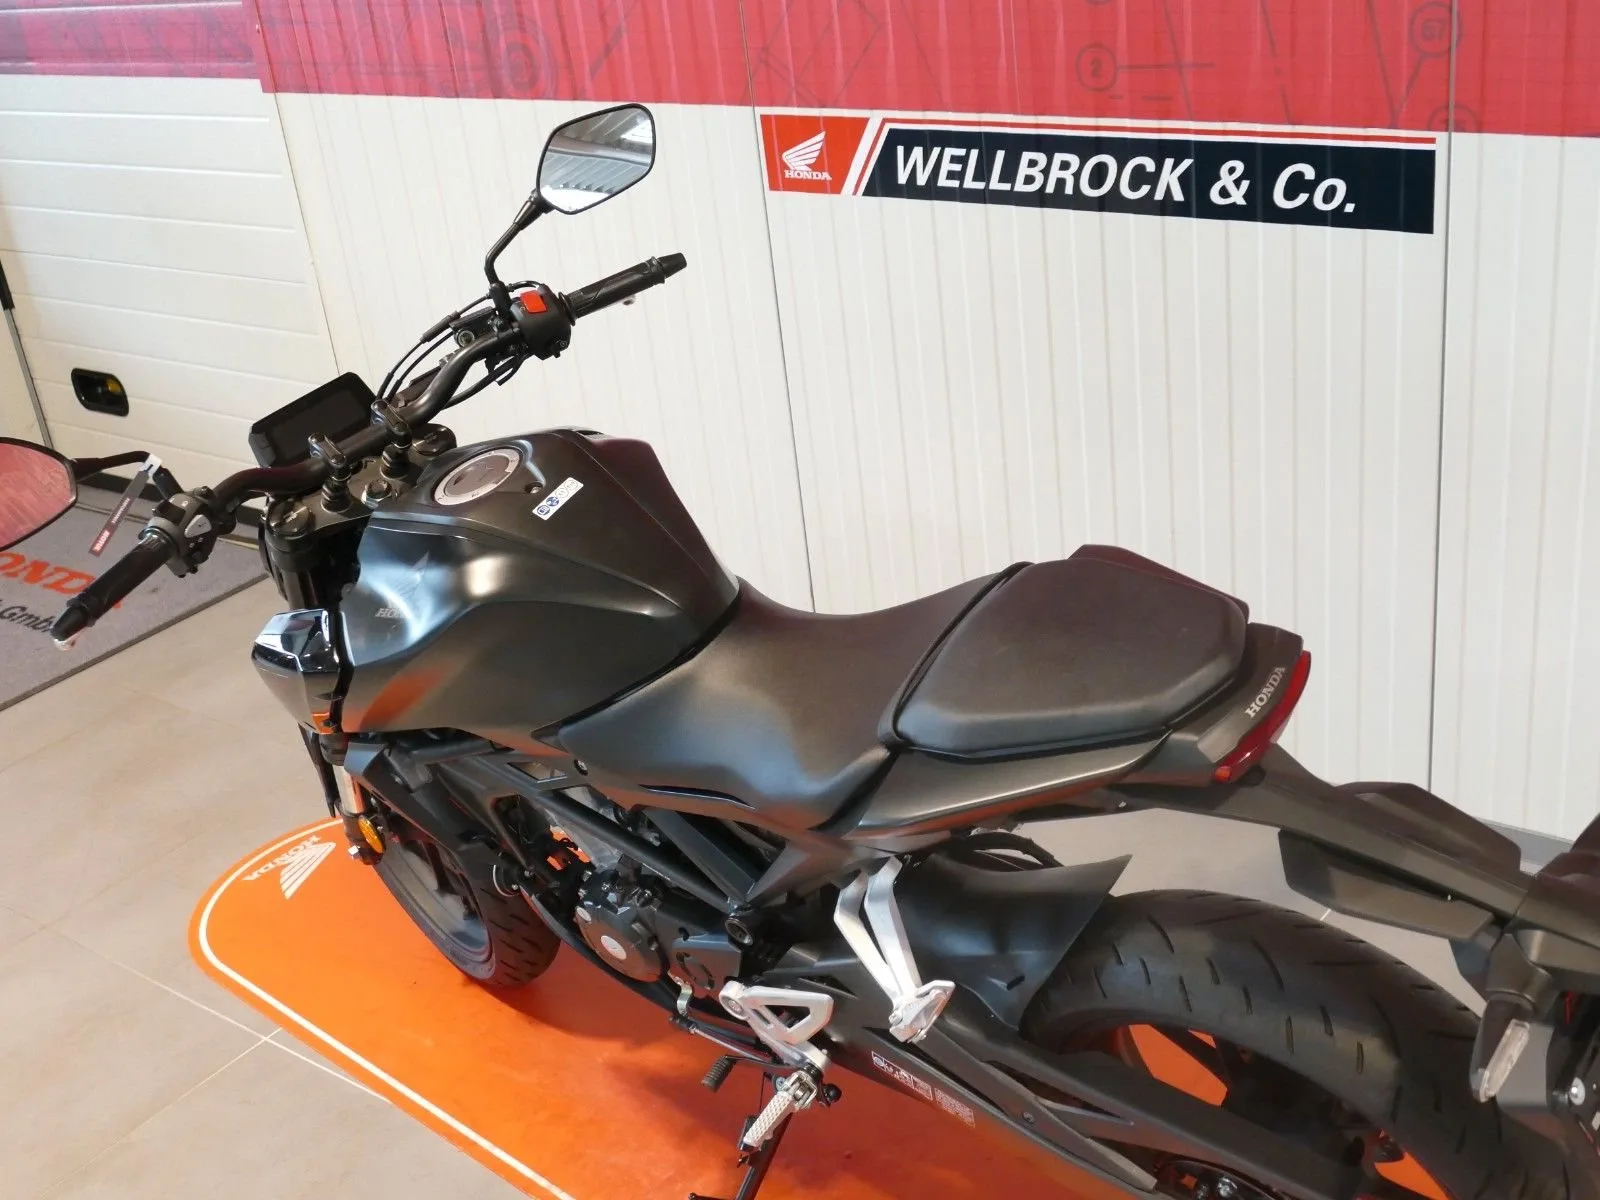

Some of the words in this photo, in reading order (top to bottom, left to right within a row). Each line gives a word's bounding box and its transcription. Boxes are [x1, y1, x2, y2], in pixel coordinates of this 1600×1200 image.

[1090, 56, 1105, 78] 2
[784, 169, 832, 181] HONDA
[896, 145, 1194, 202] WELLBROCK
[1209, 159, 1250, 206] &
[1272, 162, 1356, 213] Co.
[0, 551, 106, 600] OND
[0, 605, 56, 633] Gmb
[1245, 667, 1286, 718] HONDA
